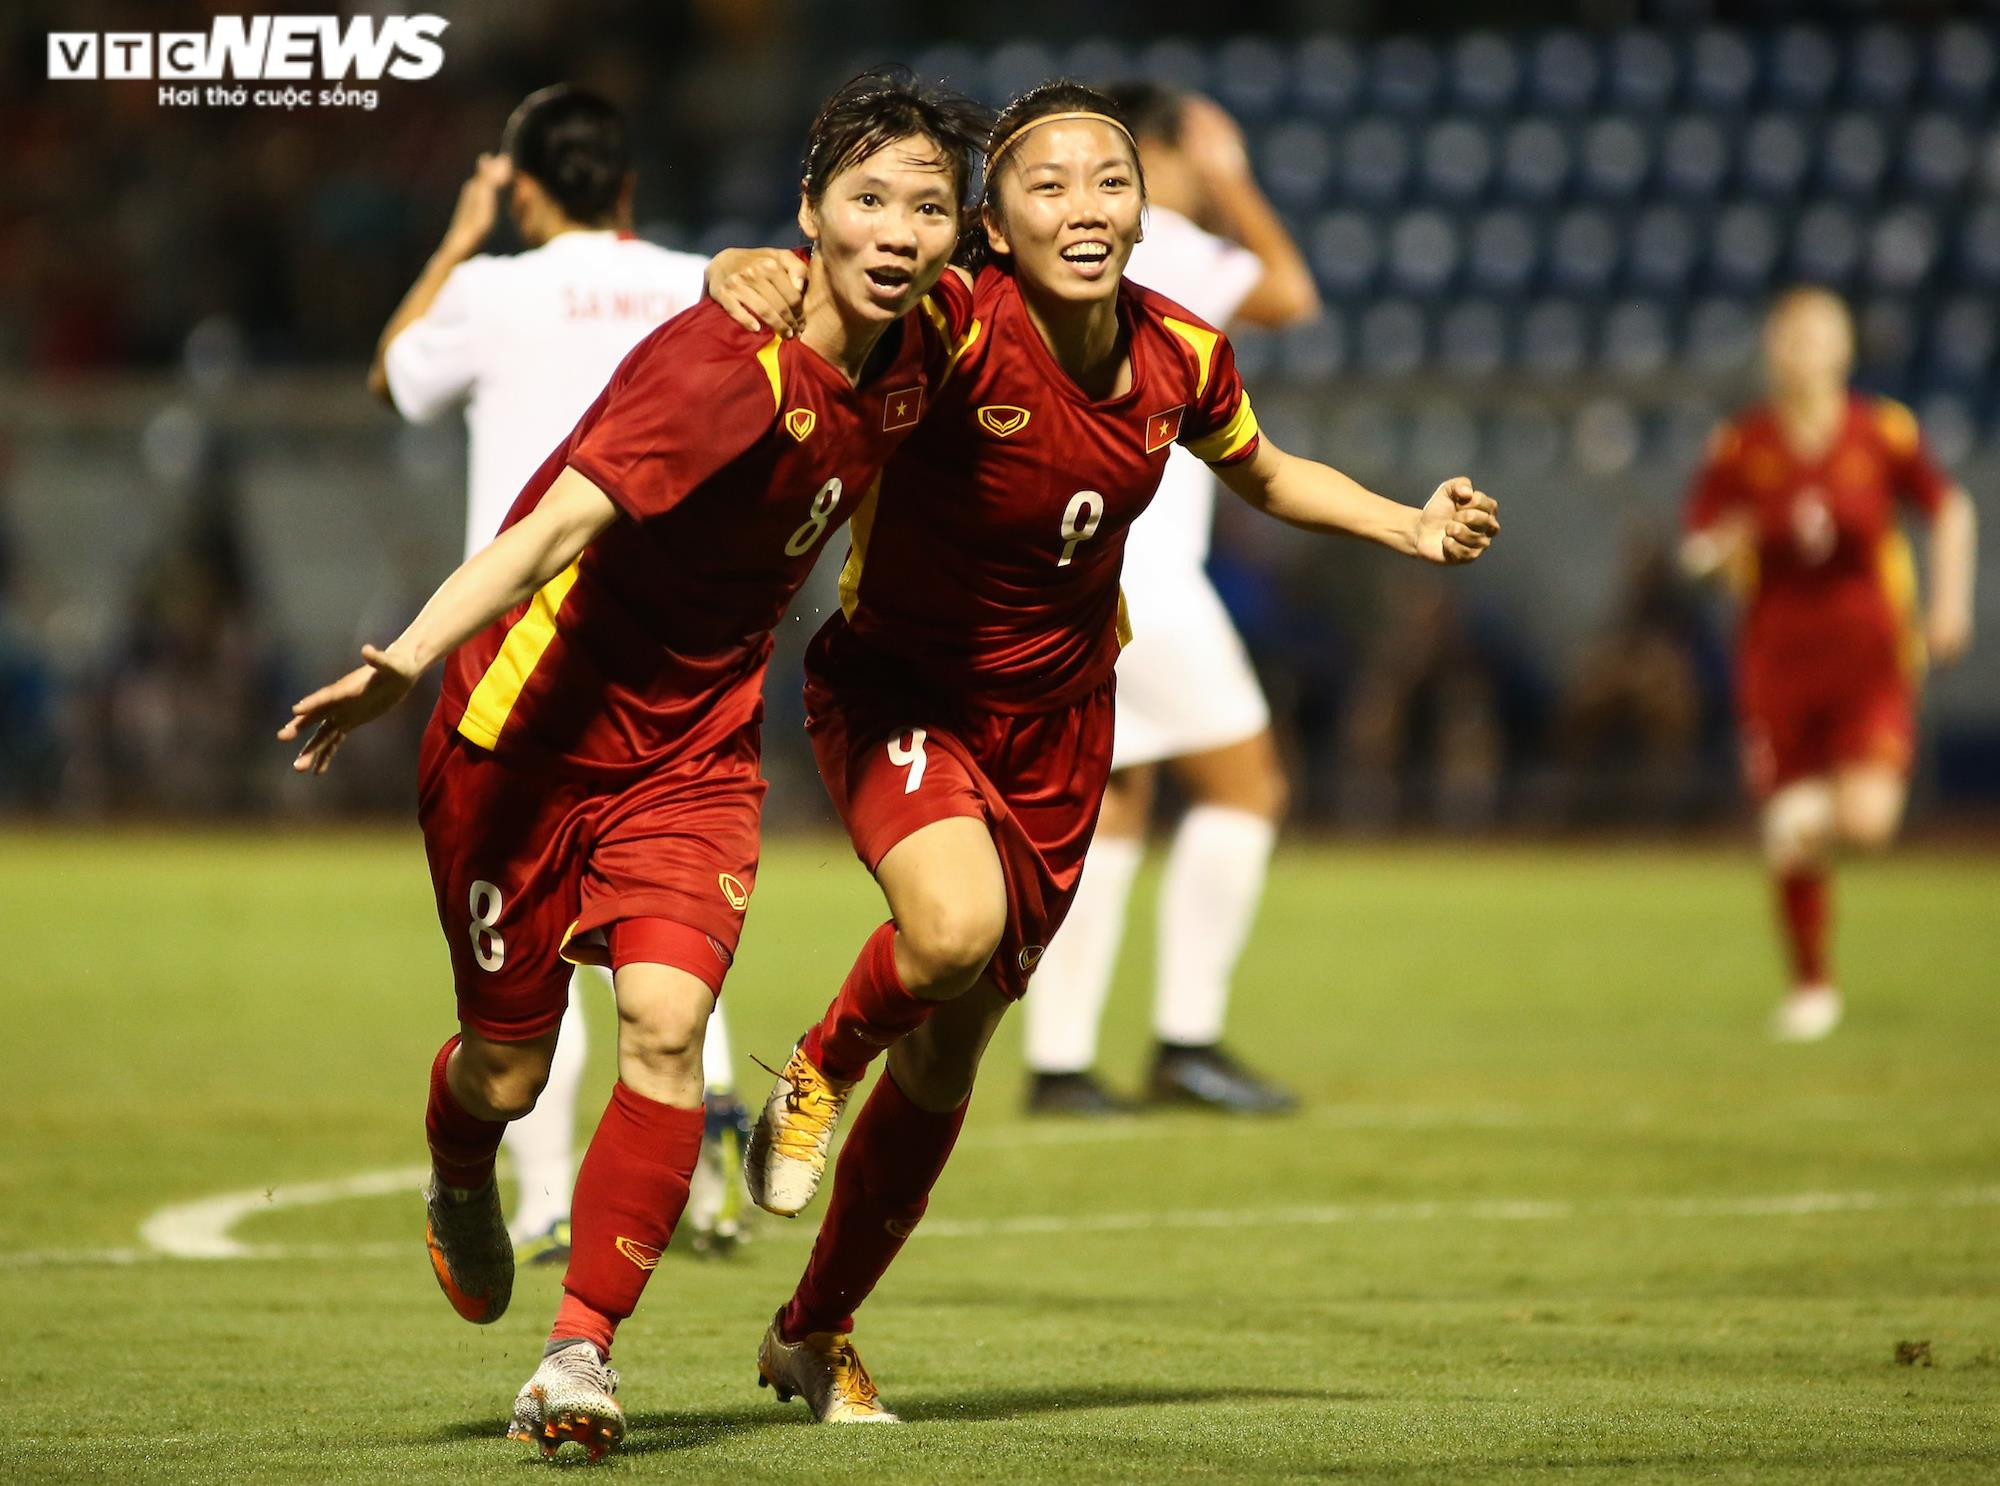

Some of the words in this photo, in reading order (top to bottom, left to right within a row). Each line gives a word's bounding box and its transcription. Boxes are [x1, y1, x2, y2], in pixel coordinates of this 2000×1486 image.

[784, 477, 843, 557] 8
[1057, 490, 1104, 567] 9
[885, 727, 928, 794] 9
[468, 879, 505, 973] 8
